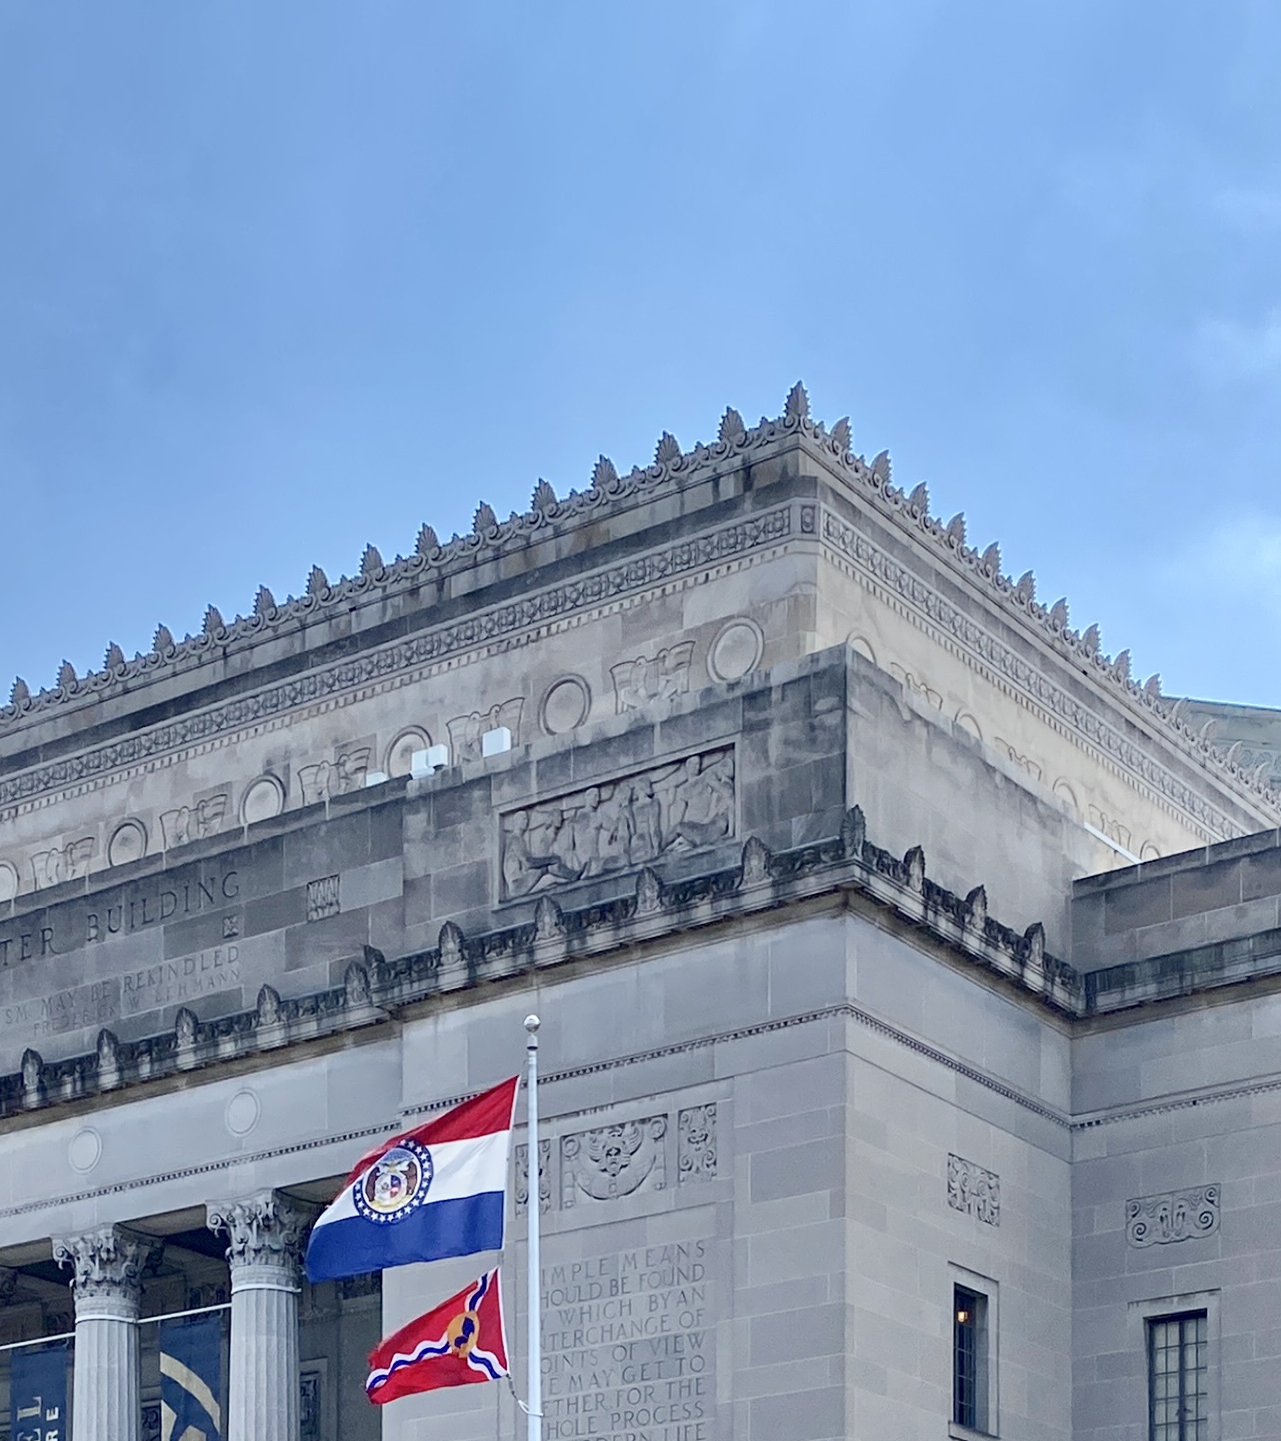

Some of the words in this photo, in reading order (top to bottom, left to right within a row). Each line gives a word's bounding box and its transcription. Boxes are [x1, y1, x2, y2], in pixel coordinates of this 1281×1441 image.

[87, 871, 239, 942] BUILDING
[42, 988, 77, 1016] MAY
[91, 980, 111, 1003] BE
[124, 945, 239, 993] REKINDLED
[542, 1258, 609, 1286] IMPLE
[622, 1240, 705, 1272] MEANS
[540, 1283, 602, 1308] HOULD
[610, 1276, 631, 1296] BE
[639, 1264, 705, 1290] FOUND
[541, 1314, 669, 1351] TERCHANGE
[679, 1308, 705, 1328] OF
[559, 1299, 632, 1325] WHICH
[541, 1350, 598, 1374] OINTS
[612, 1343, 638, 1362] OF
[648, 1332, 706, 1355] VIEW
[570, 1368, 614, 1393] MAY
[622, 1361, 665, 1383] GET
[675, 1355, 705, 1373] TO
[617, 1385, 655, 1407] FOR
[667, 1378, 706, 1400] THE
[547, 1416, 598, 1440] HOLE
[611, 1401, 704, 1430] PROCESS
